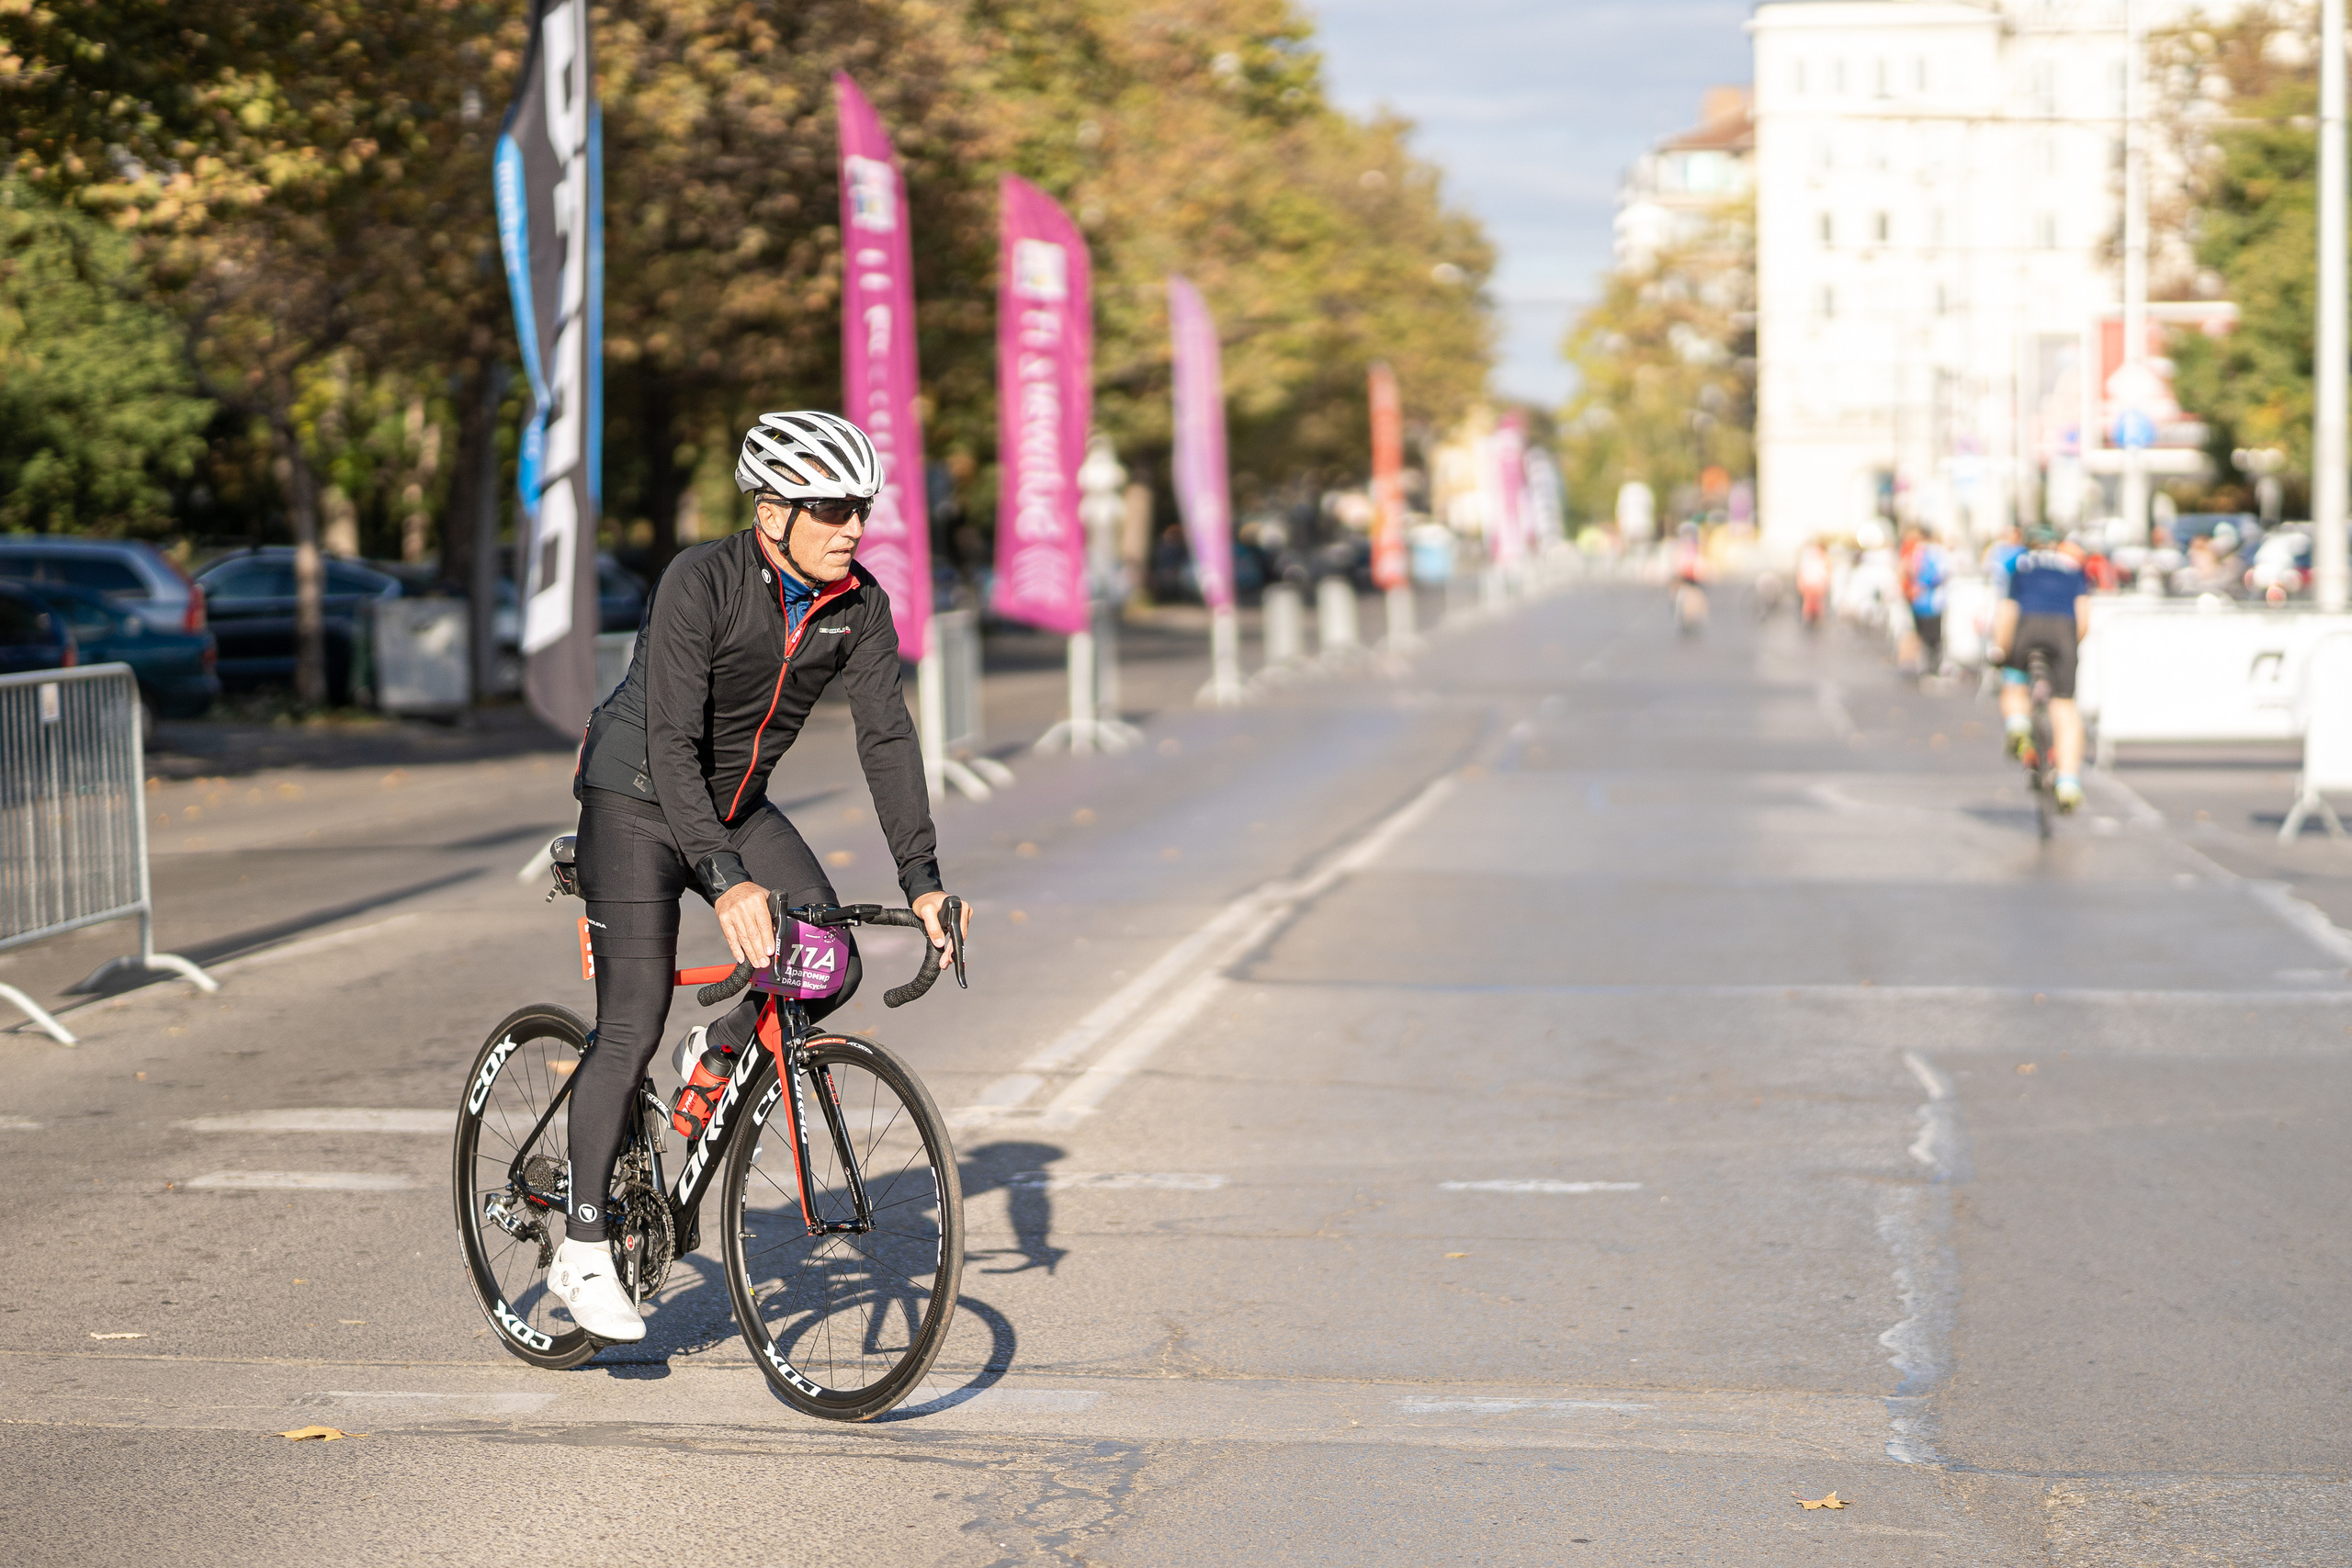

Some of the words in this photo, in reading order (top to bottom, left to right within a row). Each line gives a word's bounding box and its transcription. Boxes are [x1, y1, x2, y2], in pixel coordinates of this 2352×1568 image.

[781, 977, 801, 987] DRAG
[785, 965, 831, 982] Драгомир
[469, 1033, 516, 1115] COX
[679, 1032, 759, 1205] DRAG
[493, 1299, 552, 1351] COX
[763, 1340, 822, 1397] COX
